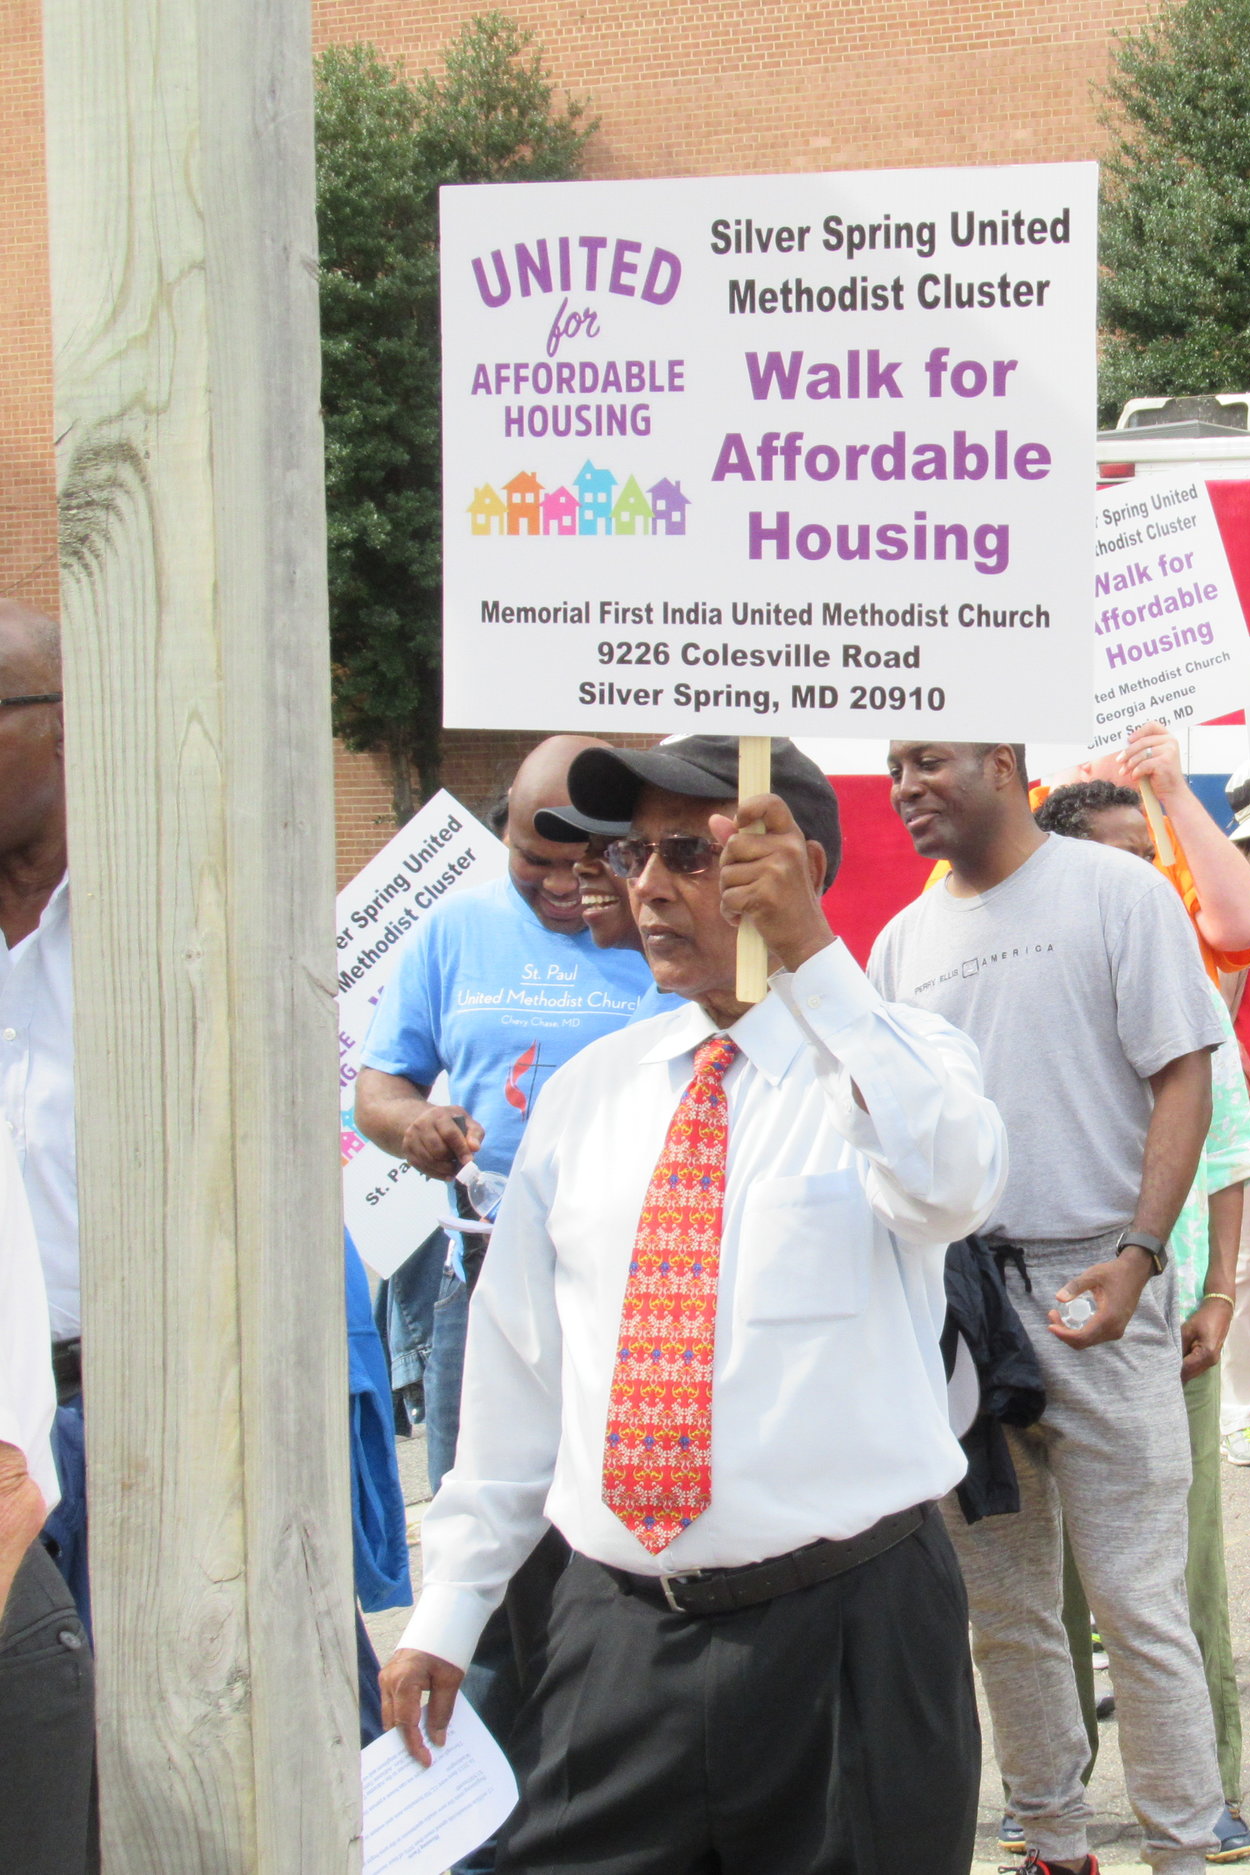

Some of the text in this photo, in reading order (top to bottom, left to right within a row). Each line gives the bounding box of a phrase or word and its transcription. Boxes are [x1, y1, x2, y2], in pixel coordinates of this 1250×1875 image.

[709, 207, 1071, 259] Silver Spring United
[471, 235, 683, 308] UNITED
[728, 273, 1051, 314] Methodist Cluster
[546, 297, 601, 357] for
[470, 359, 686, 395] AFFORDABLE
[745, 348, 1019, 400] Walk for
[503, 404, 652, 437] HOUSING
[711, 429, 1052, 482] Affordable
[1102, 502, 1149, 527] Spring
[1151, 483, 1198, 510] United
[747, 511, 1010, 575] Housing
[1095, 514, 1197, 557] hodist Cluster
[1158, 552, 1194, 577] for
[480, 601, 1051, 629] Memorial First India United Methodist Church
[597, 642, 921, 669] 9226 Colesville Road
[1105, 621, 1214, 669] Housing
[578, 681, 946, 714] Silver Spring, MD 20910
[1095, 651, 1231, 704] ted Methodist Church
[1096, 685, 1196, 725] Georgia Avenue
[1174, 705, 1194, 720] MD
[350, 814, 463, 929] Spring United
[338, 847, 476, 994] Methodist Cluster
[521, 963, 578, 981] St. Paul
[914, 943, 1054, 995] PERRY ELLIS AMERICA
[457, 988, 504, 1006] United
[506, 990, 582, 1008] Methodist
[501, 1015, 528, 1027] Chevy
[562, 1018, 580, 1028] MD
[365, 1185, 390, 1206] St.
